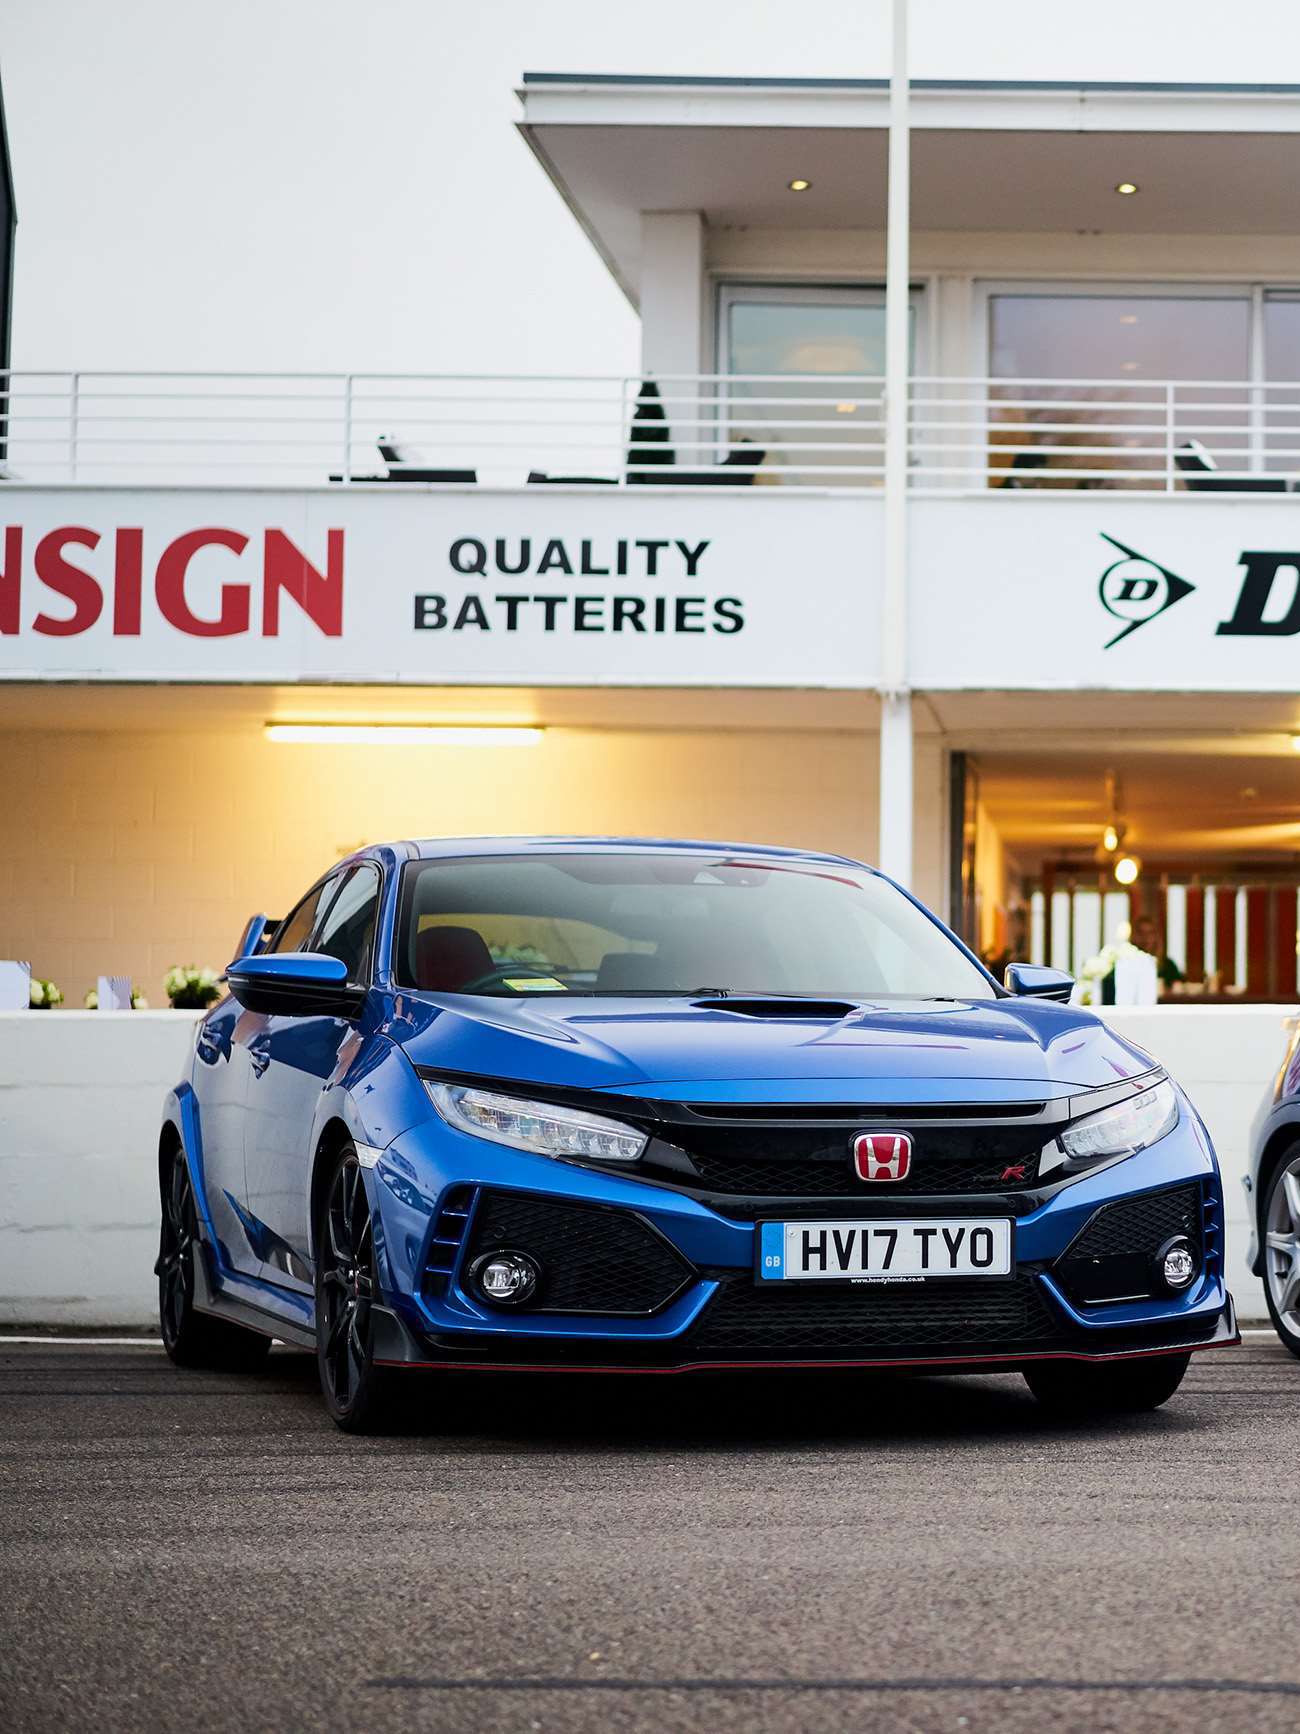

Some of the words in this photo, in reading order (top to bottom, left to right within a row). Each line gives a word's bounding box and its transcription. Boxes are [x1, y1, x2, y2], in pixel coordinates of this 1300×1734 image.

[449, 538, 711, 577] QUALITY
[0, 525, 345, 639] SIGN
[413, 595, 746, 634] BATTERIES
[765, 1255, 781, 1267] GB
[801, 1229, 899, 1271] HV17
[913, 1227, 994, 1269] TYO
